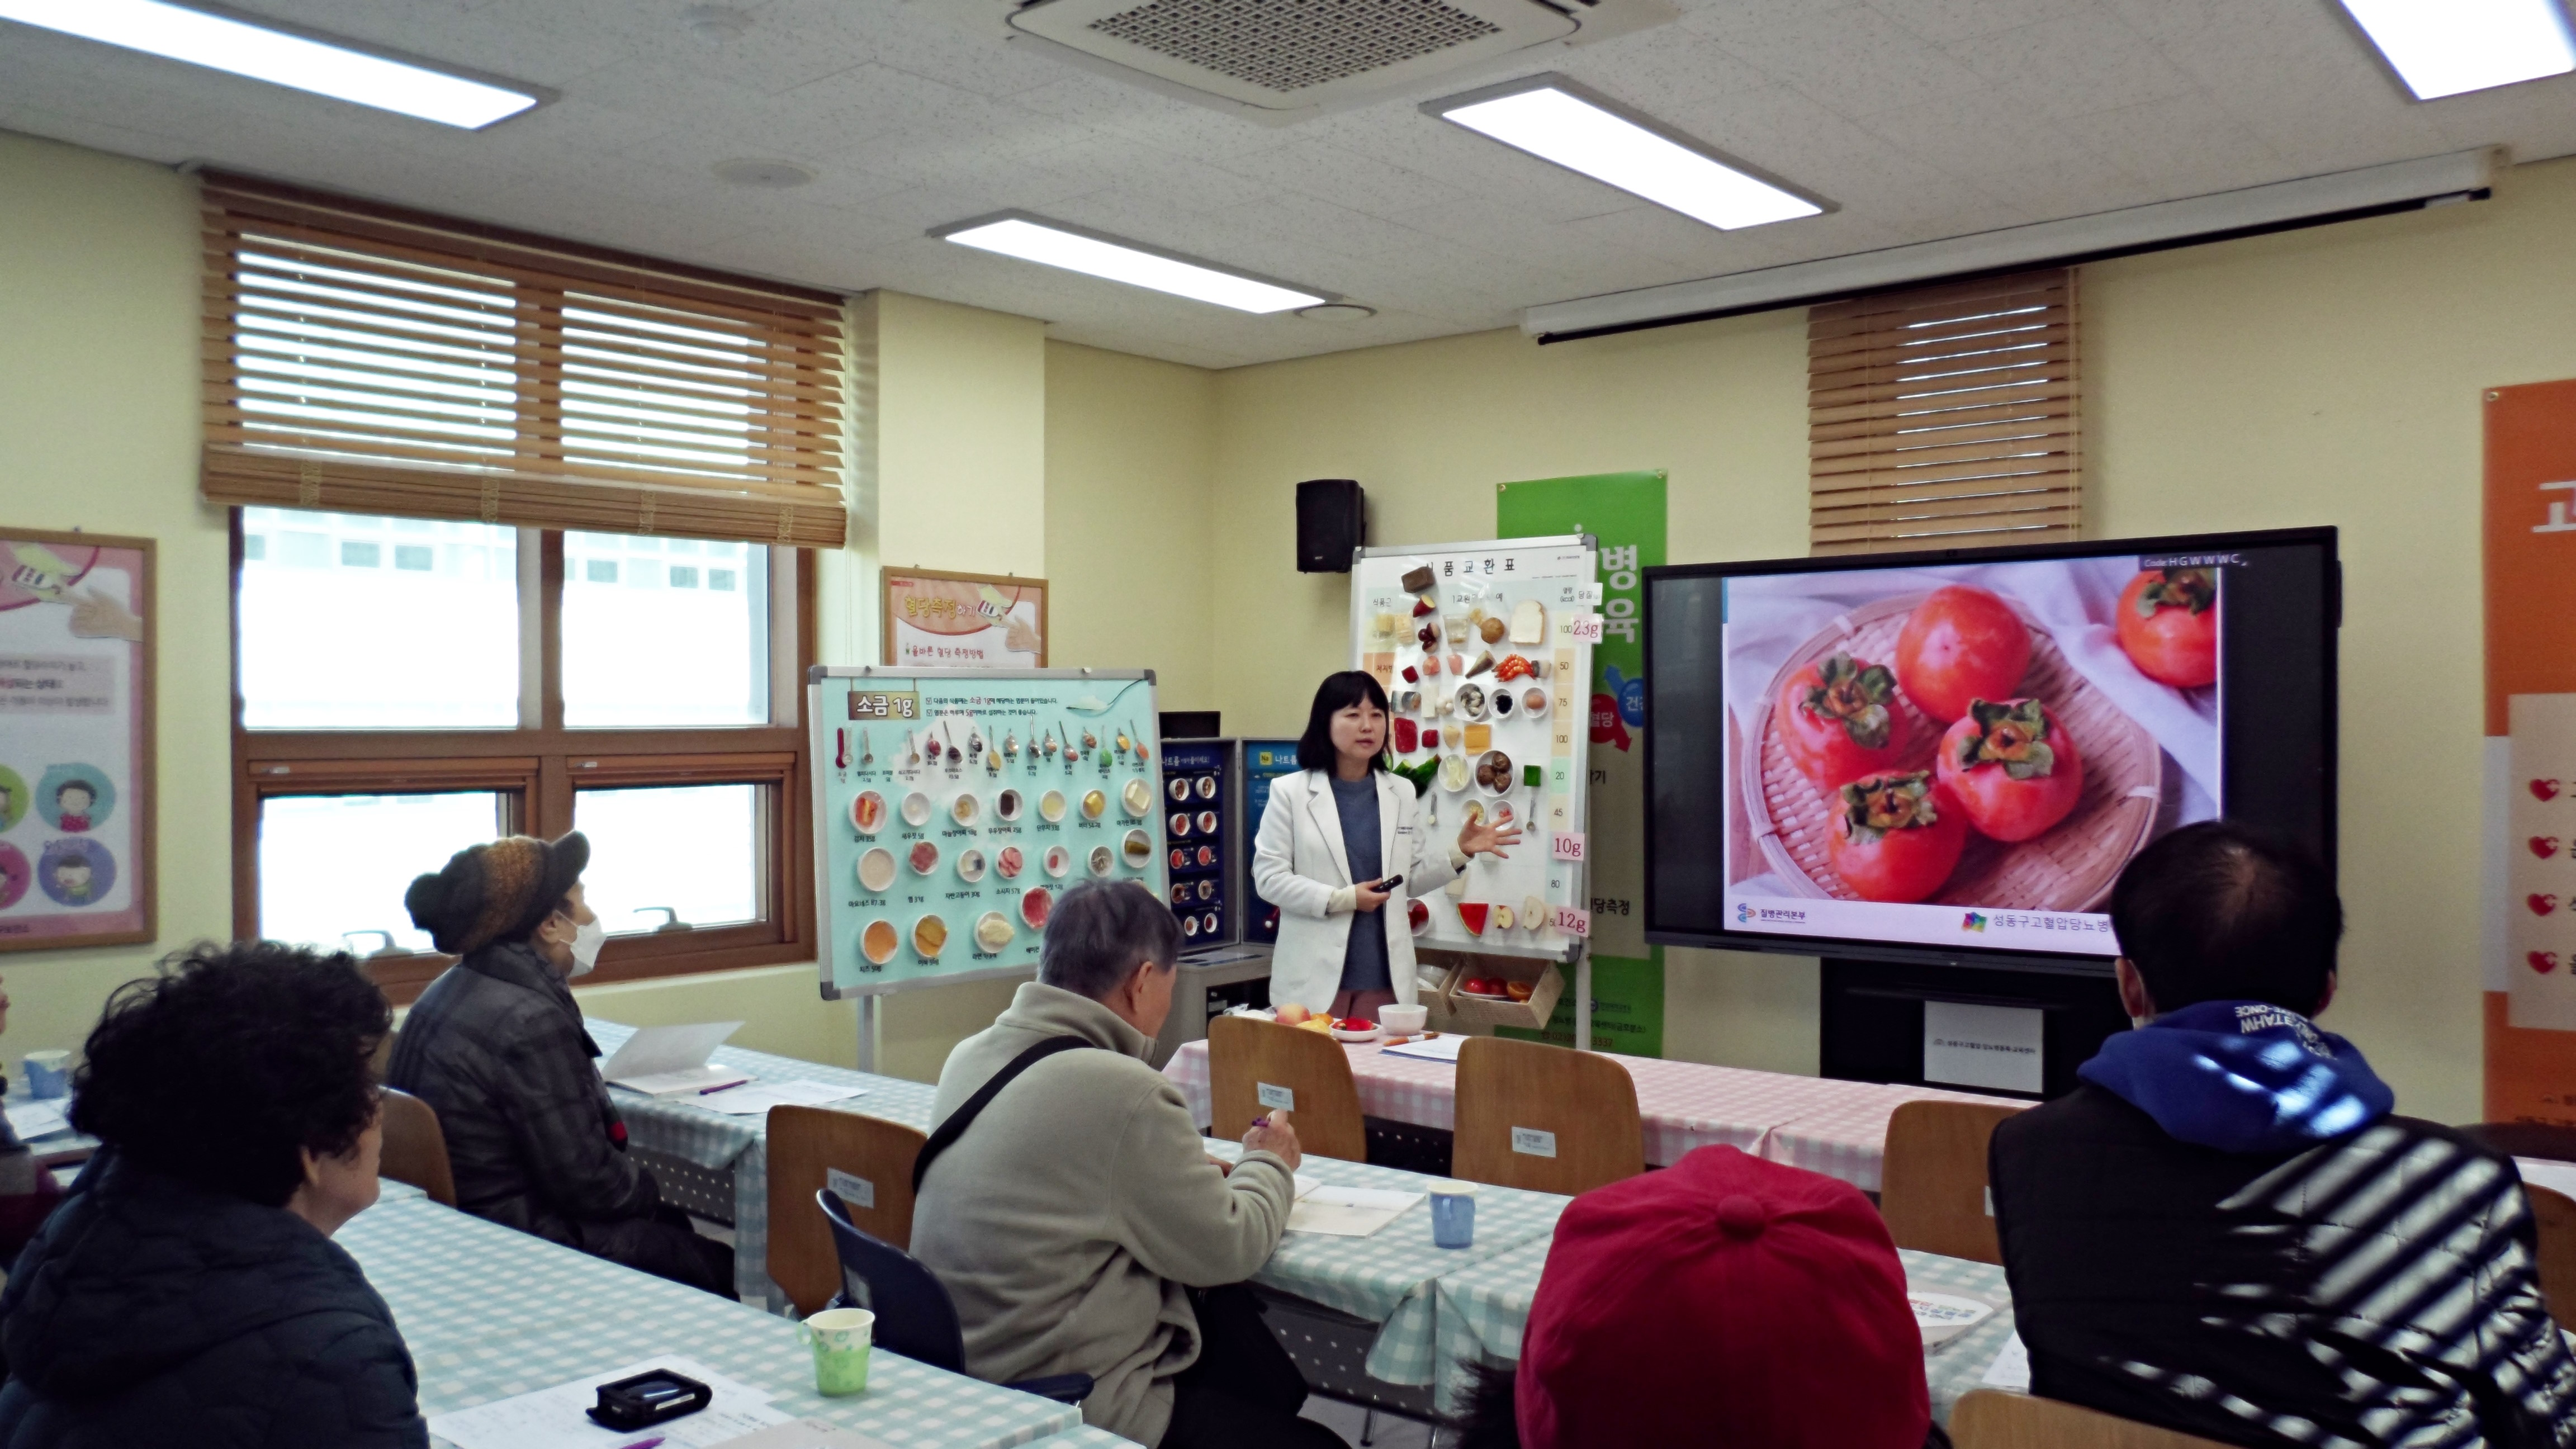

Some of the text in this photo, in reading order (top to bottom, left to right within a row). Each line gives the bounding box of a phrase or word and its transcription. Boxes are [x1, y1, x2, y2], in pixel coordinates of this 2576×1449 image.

[904, 594, 976, 620] 혈당측정하기
[1560, 624, 1573, 633] 100
[1573, 620, 1598, 638] 23g
[1560, 661, 1569, 670] 50
[969, 696, 982, 705] 소금
[1559, 697, 1568, 707] 75
[856, 695, 913, 717] 소금 1g
[1555, 734, 1568, 744] 100
[1555, 771, 1565, 780] 20
[1554, 808, 1563, 817] 45
[1554, 837, 1581, 858] 10g
[1551, 879, 1560, 888] 80
[1559, 912, 1586, 934] 12g
